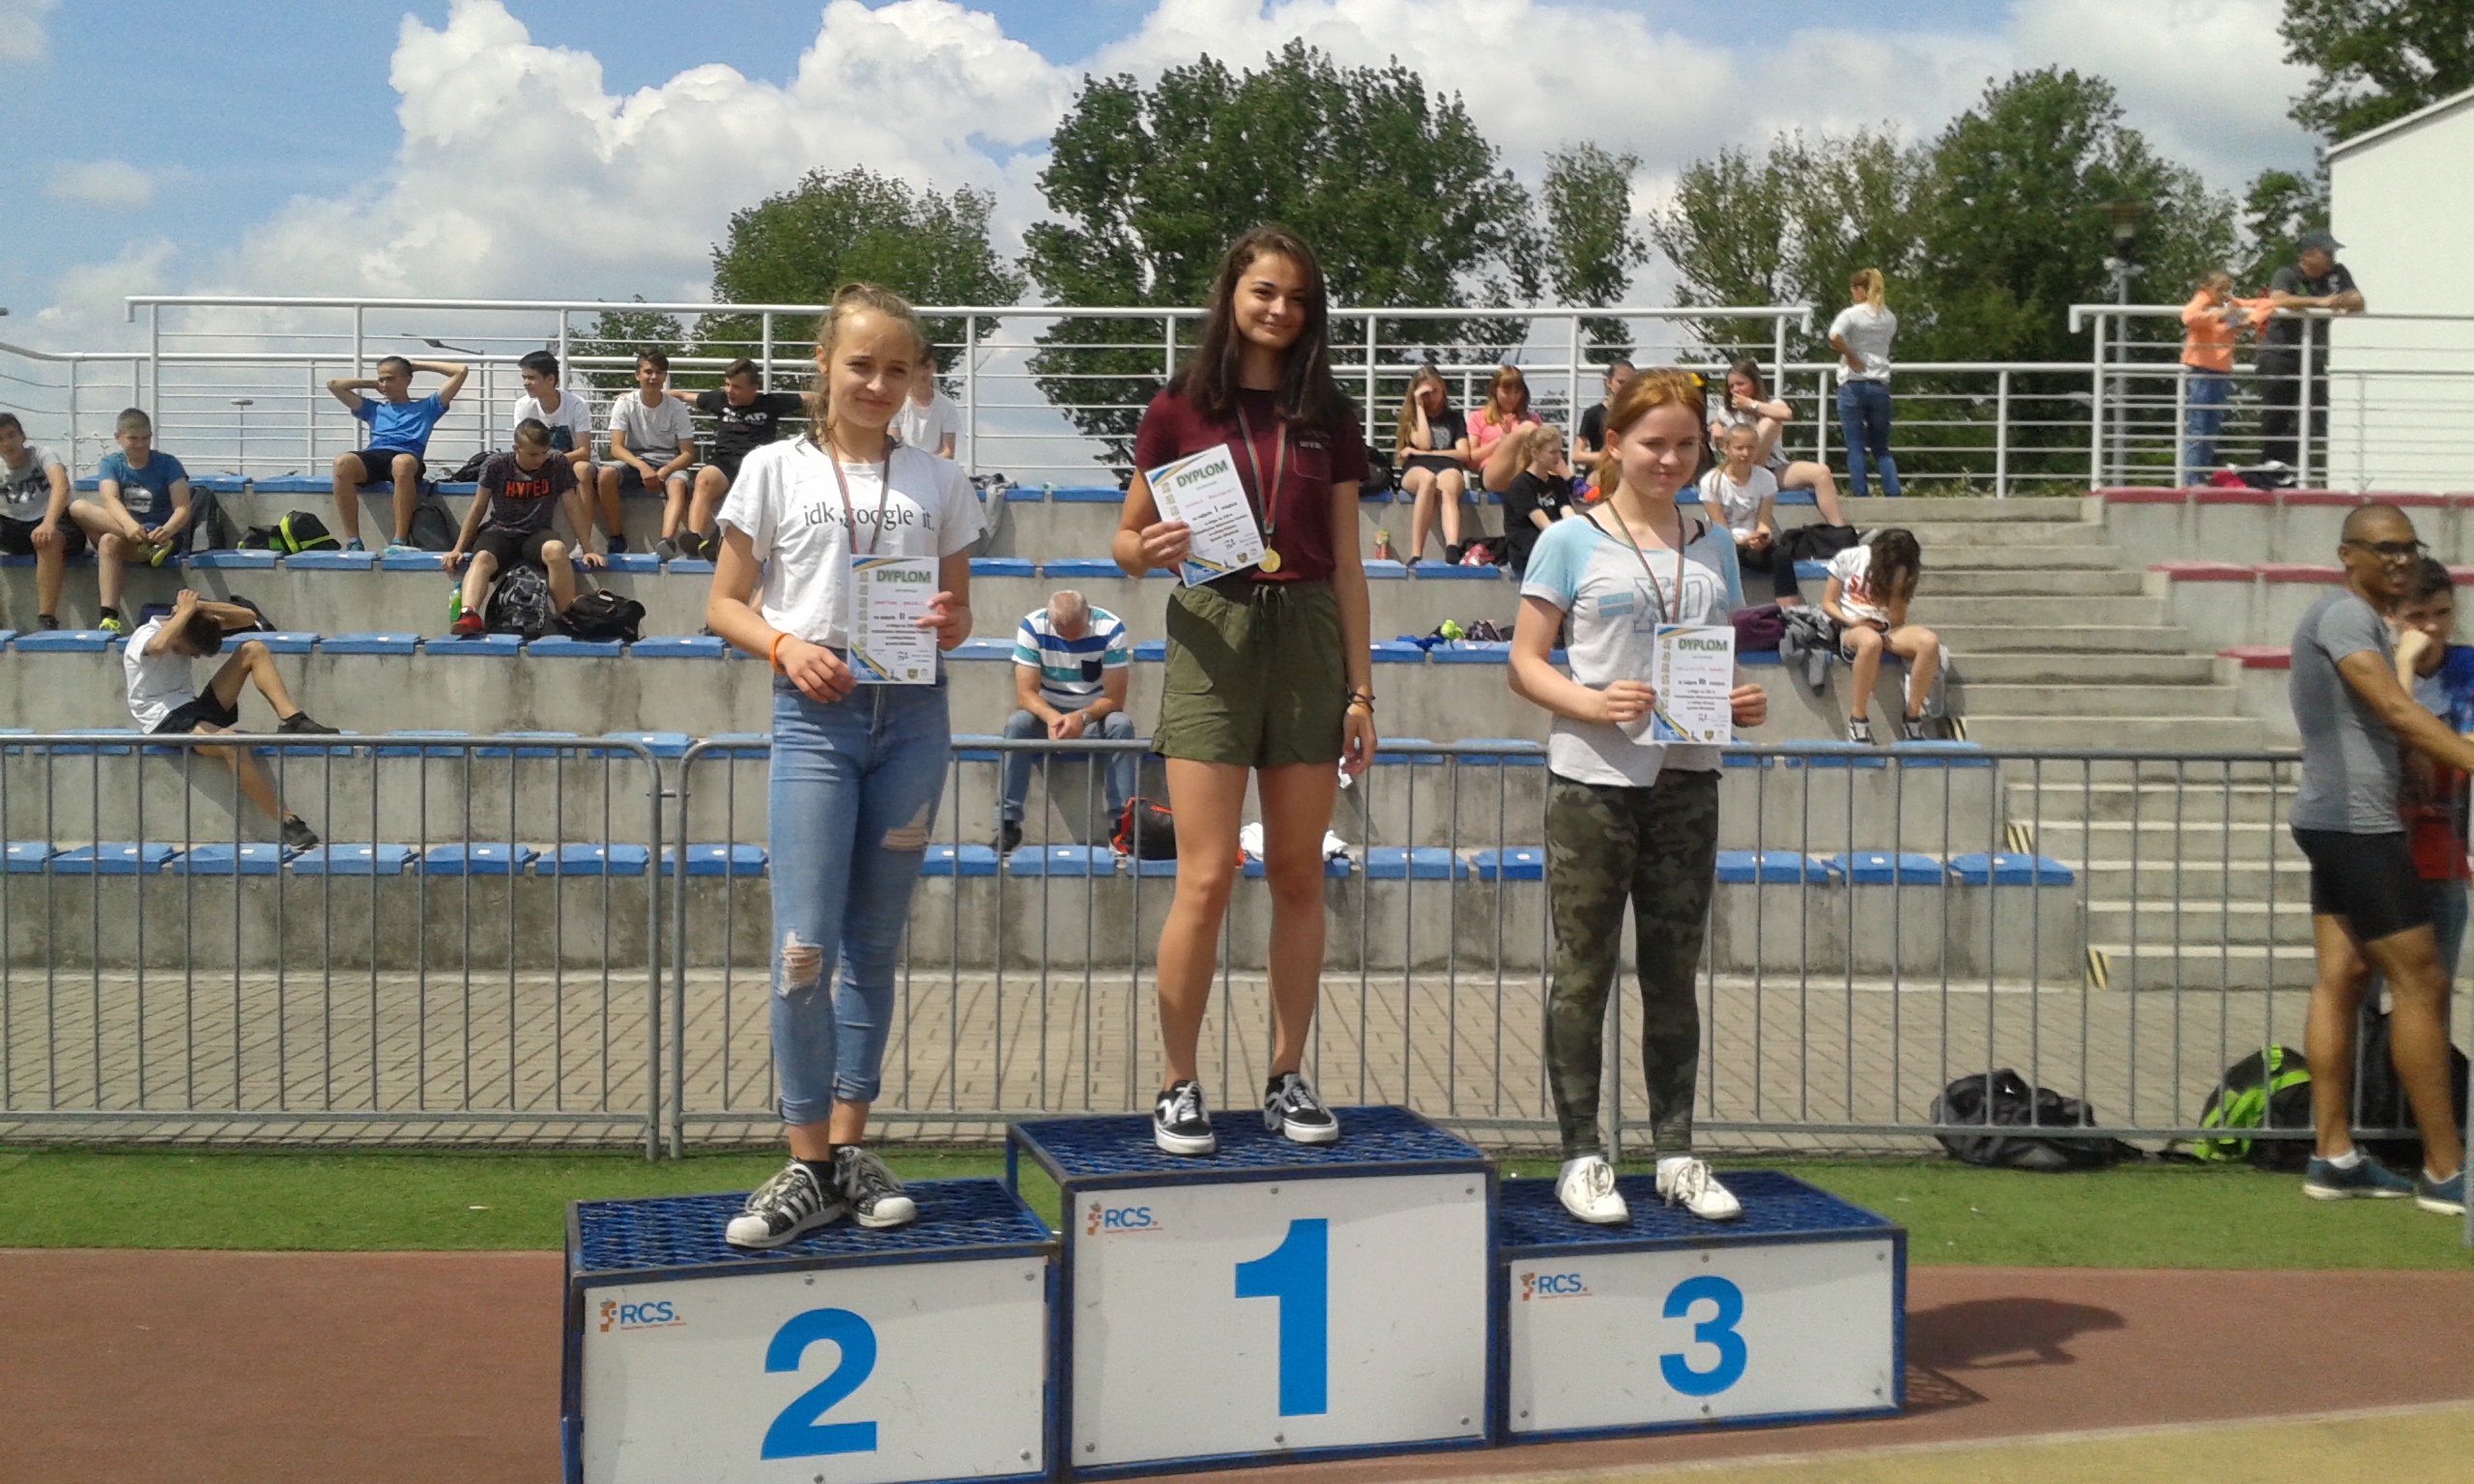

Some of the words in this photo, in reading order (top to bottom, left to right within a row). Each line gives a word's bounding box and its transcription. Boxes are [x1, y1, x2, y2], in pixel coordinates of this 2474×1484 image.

[1176, 460, 1228, 487] DYPLOM
[505, 478, 550, 498] HYPED
[877, 570, 932, 584] DYPLOM
[1679, 639, 1728, 651] DYPLOM
[1236, 1219, 1328, 1417] 1
[1660, 1276, 1747, 1397] 3
[762, 1308, 877, 1460] 2
